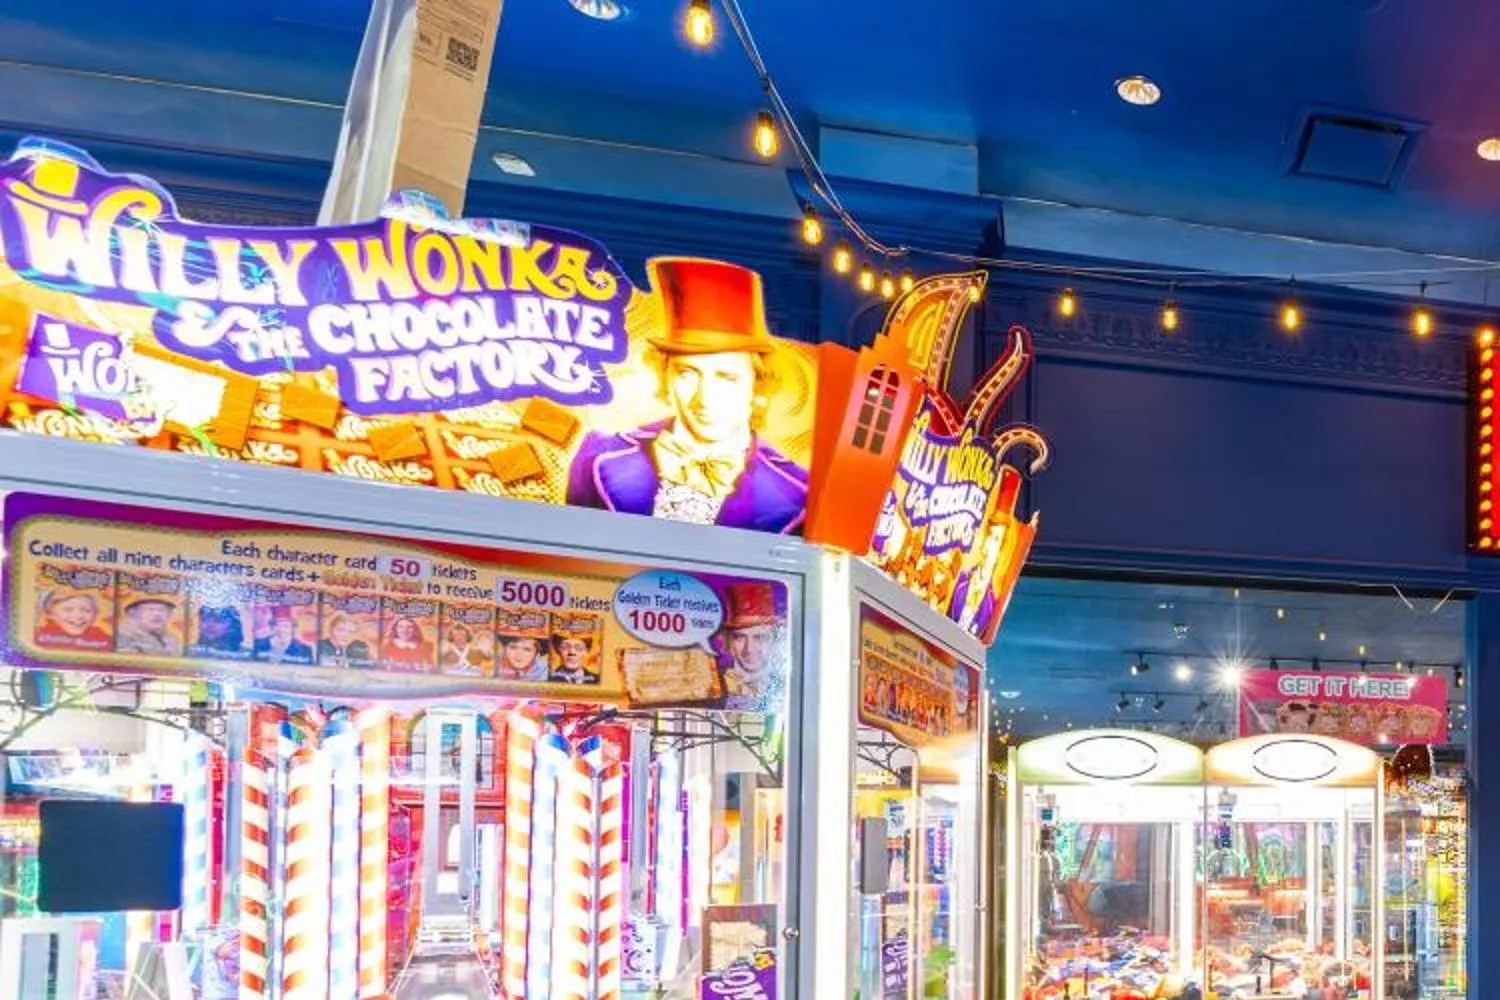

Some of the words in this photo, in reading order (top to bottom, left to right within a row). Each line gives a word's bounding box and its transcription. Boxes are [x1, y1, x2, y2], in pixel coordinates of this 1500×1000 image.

[8, 186, 318, 306] WILLY
[331, 217, 617, 301] WONKA
[308, 294, 615, 353] CHOCOLATE
[350, 337, 592, 403] FACTORY
[28, 539, 88, 560] Collect
[97, 549, 118, 563] all
[125, 551, 161, 568] nine
[168, 555, 256, 578] characters
[261, 566, 303, 582] cards
[426, 582, 442, 596] to
[501, 580, 565, 608] 5000
[570, 595, 611, 613] tickets
[221, 539, 261, 559] Each
[267, 546, 338, 567] character
[344, 556, 377, 571] card
[389, 558, 421, 577] 50
[432, 565, 478, 581] tickets
[659, 576, 682, 592] Each
[630, 610, 686, 633] 1000
[1279, 674, 1322, 696] GET
[1325, 677, 1346, 697] IT
